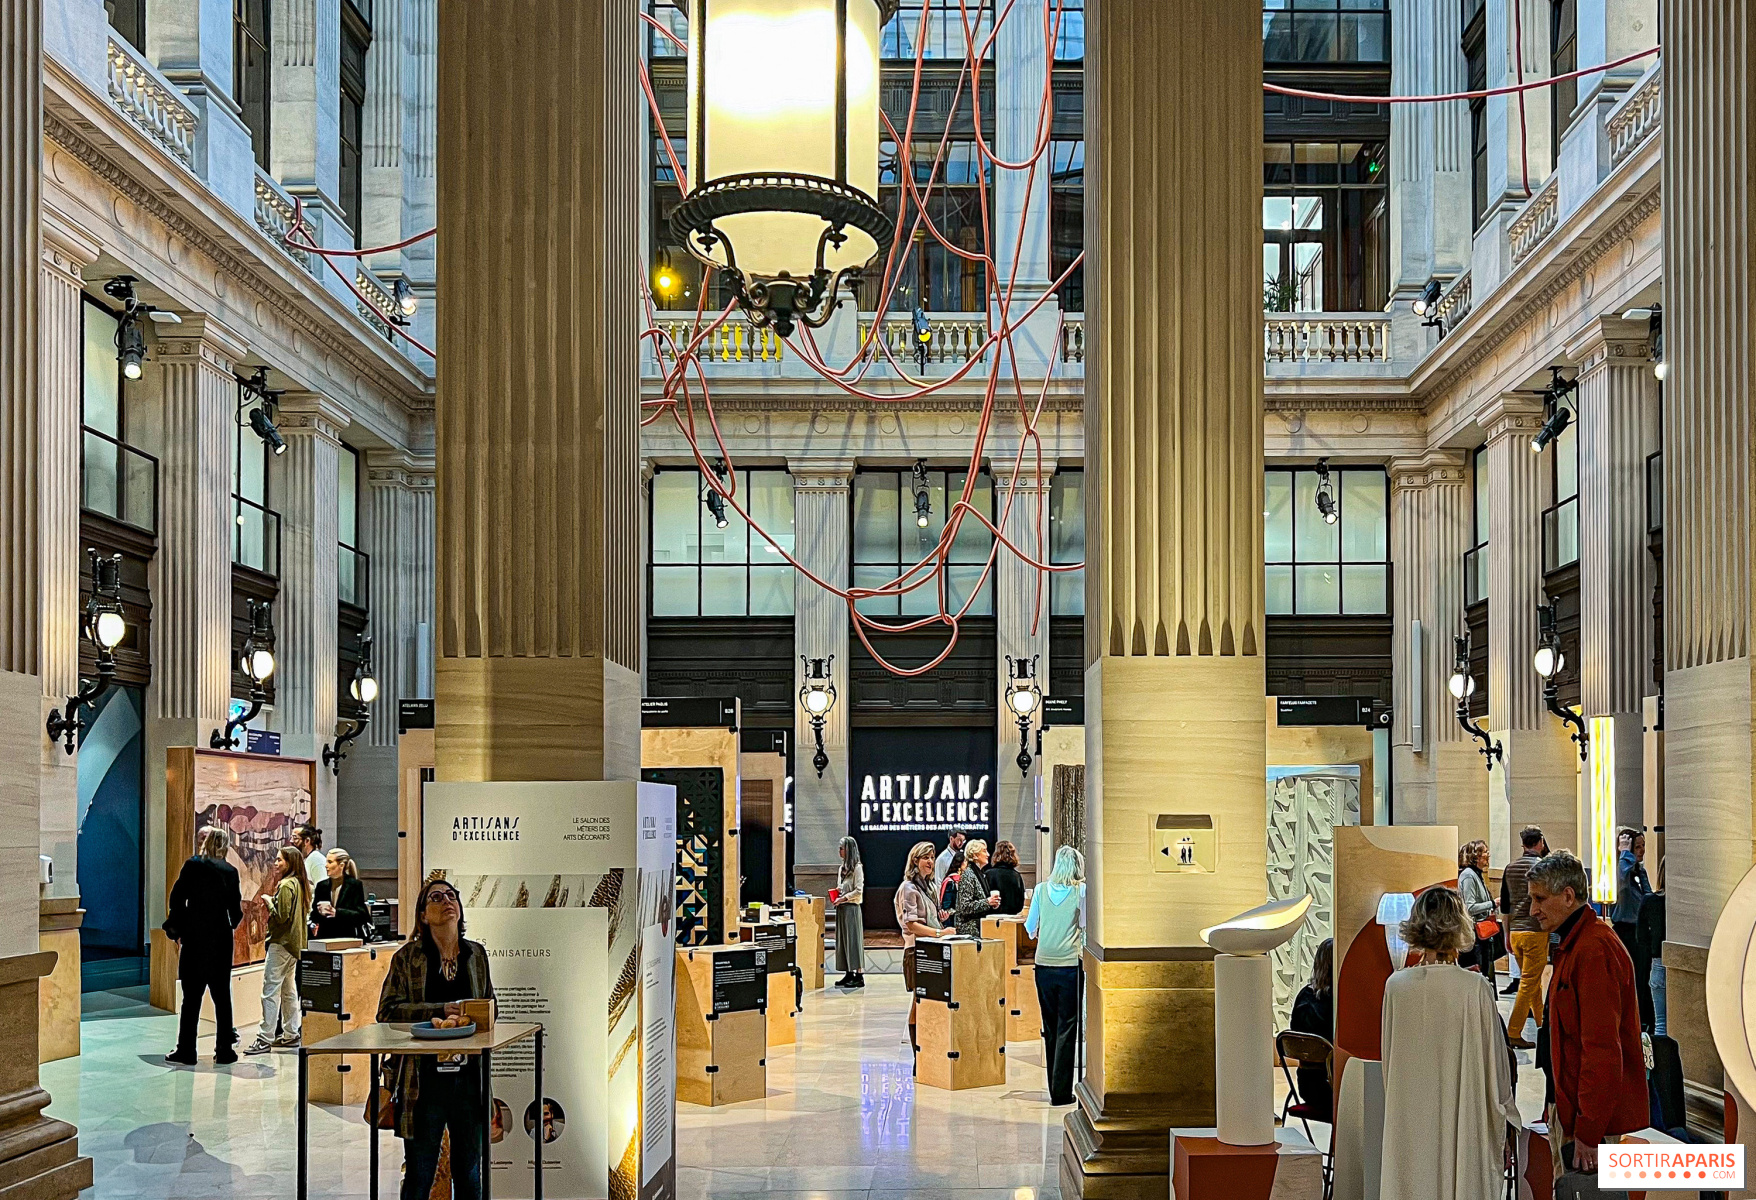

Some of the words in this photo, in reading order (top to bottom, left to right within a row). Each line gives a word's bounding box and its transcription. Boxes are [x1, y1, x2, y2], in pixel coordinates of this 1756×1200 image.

[861, 775, 990, 800] ARTISANS
[452, 816, 520, 830] ARTISANS
[576, 824, 598, 832] MÉTIERS
[452, 830, 520, 841] D'EXCELLENCE
[577, 833, 610, 841] DÉCORATIFS
[486, 949, 551, 958] GANISATEURS
